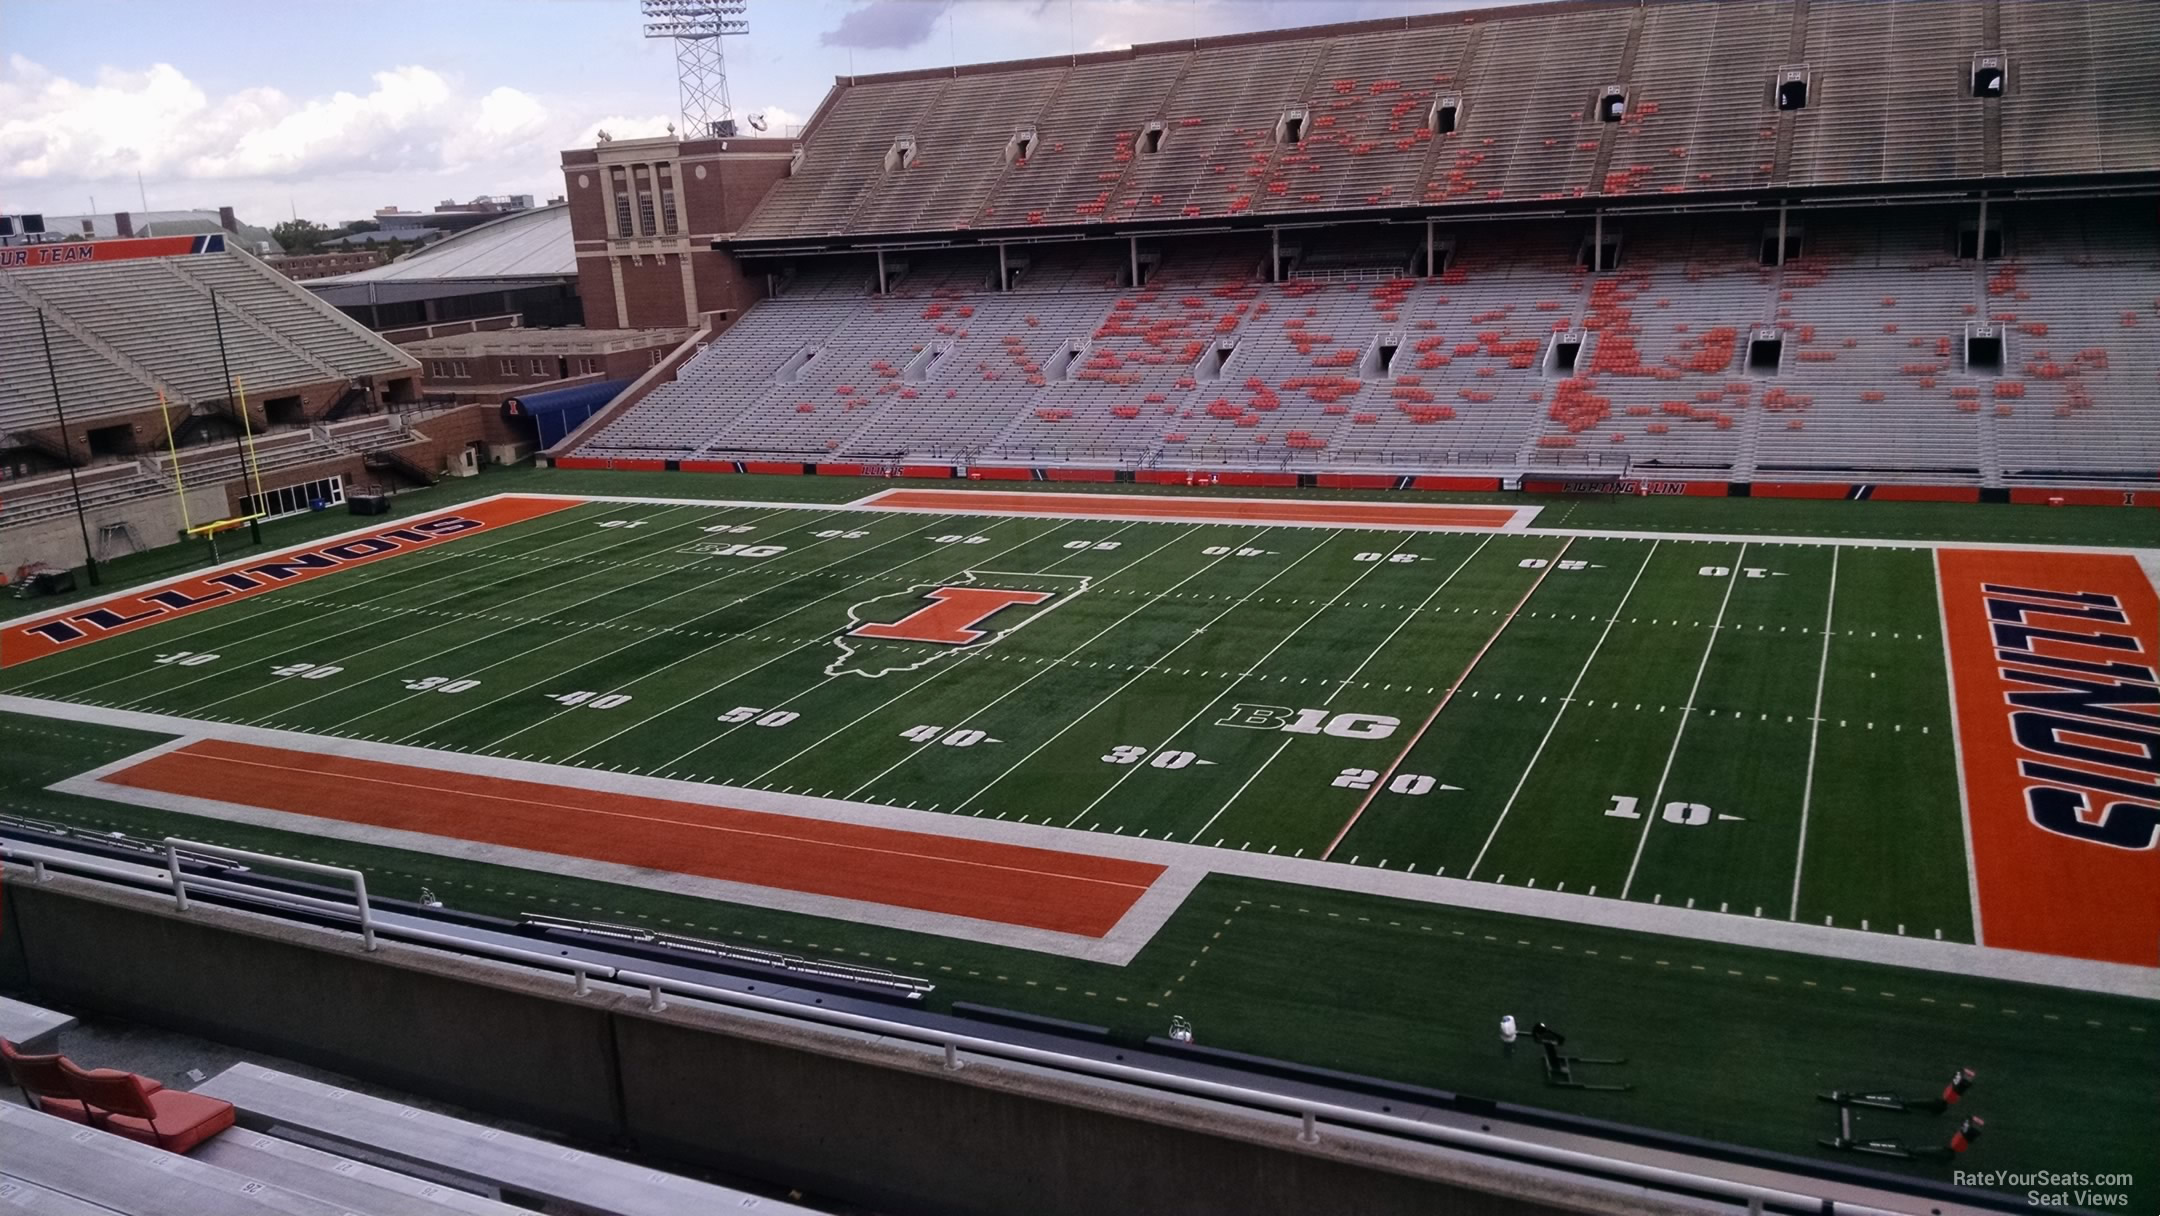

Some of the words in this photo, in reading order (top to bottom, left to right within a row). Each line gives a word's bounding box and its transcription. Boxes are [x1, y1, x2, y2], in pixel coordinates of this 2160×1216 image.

[38, 245, 94, 263] TEAM
[1562, 482, 1637, 494] FIGHTING
[1518, 558, 1588, 570] 20
[1698, 566, 1768, 578] 10
[22, 516, 486, 645] ILLINOIS
[847, 586, 1056, 645] I
[271, 663, 344, 679] 20
[406, 676, 481, 693] 30
[556, 690, 632, 709] 40
[717, 706, 800, 727] 50
[1980, 582, 2160, 851] ILLINOIS
[899, 725, 988, 747] 40
[1101, 745, 1197, 769] 30
[1331, 768, 1437, 795] 20
[1604, 795, 1711, 826] 10
[245, 1183, 262, 1193] 26
